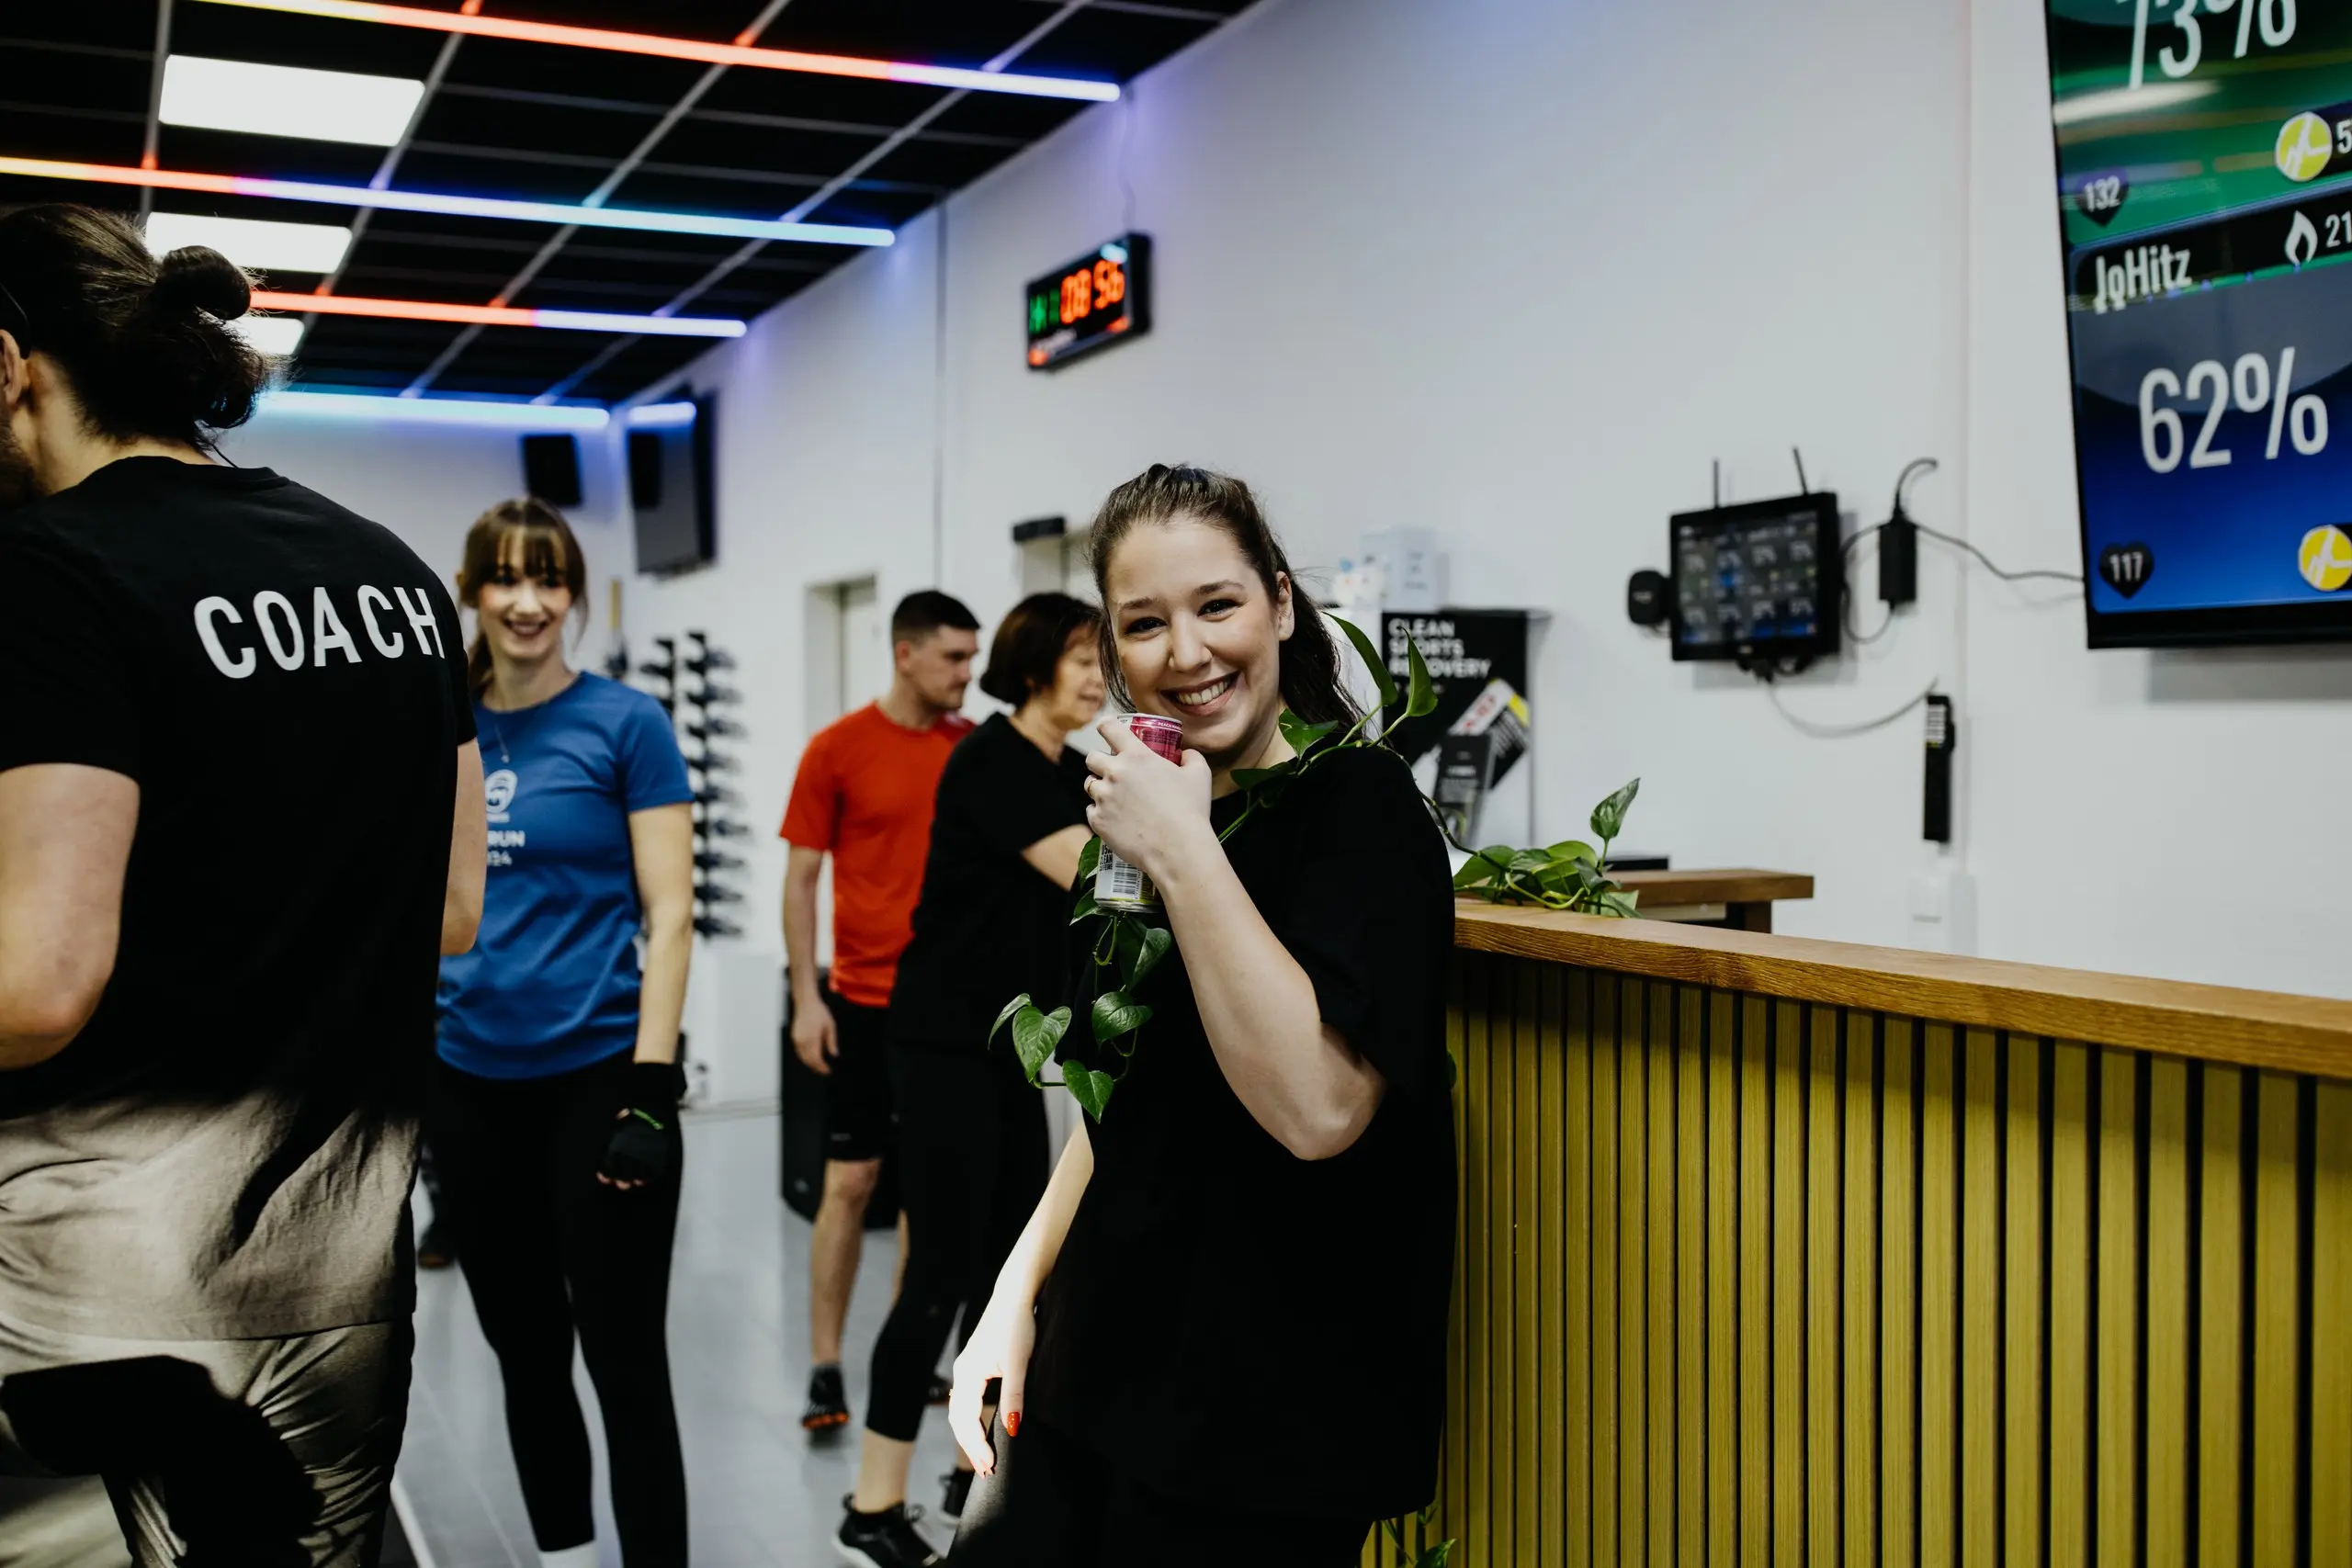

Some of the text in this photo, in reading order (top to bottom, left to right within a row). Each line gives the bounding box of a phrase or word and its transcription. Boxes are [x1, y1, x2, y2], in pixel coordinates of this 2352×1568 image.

[2116, 0, 2296, 90] 73%
[2084, 175, 2121, 212] 132
[2139, 346, 2329, 474] 62%
[2109, 552, 2143, 582] 117
[194, 584, 446, 679] COACH
[1388, 617, 1455, 637] CLEAN
[1388, 657, 1492, 679] REOVERY
